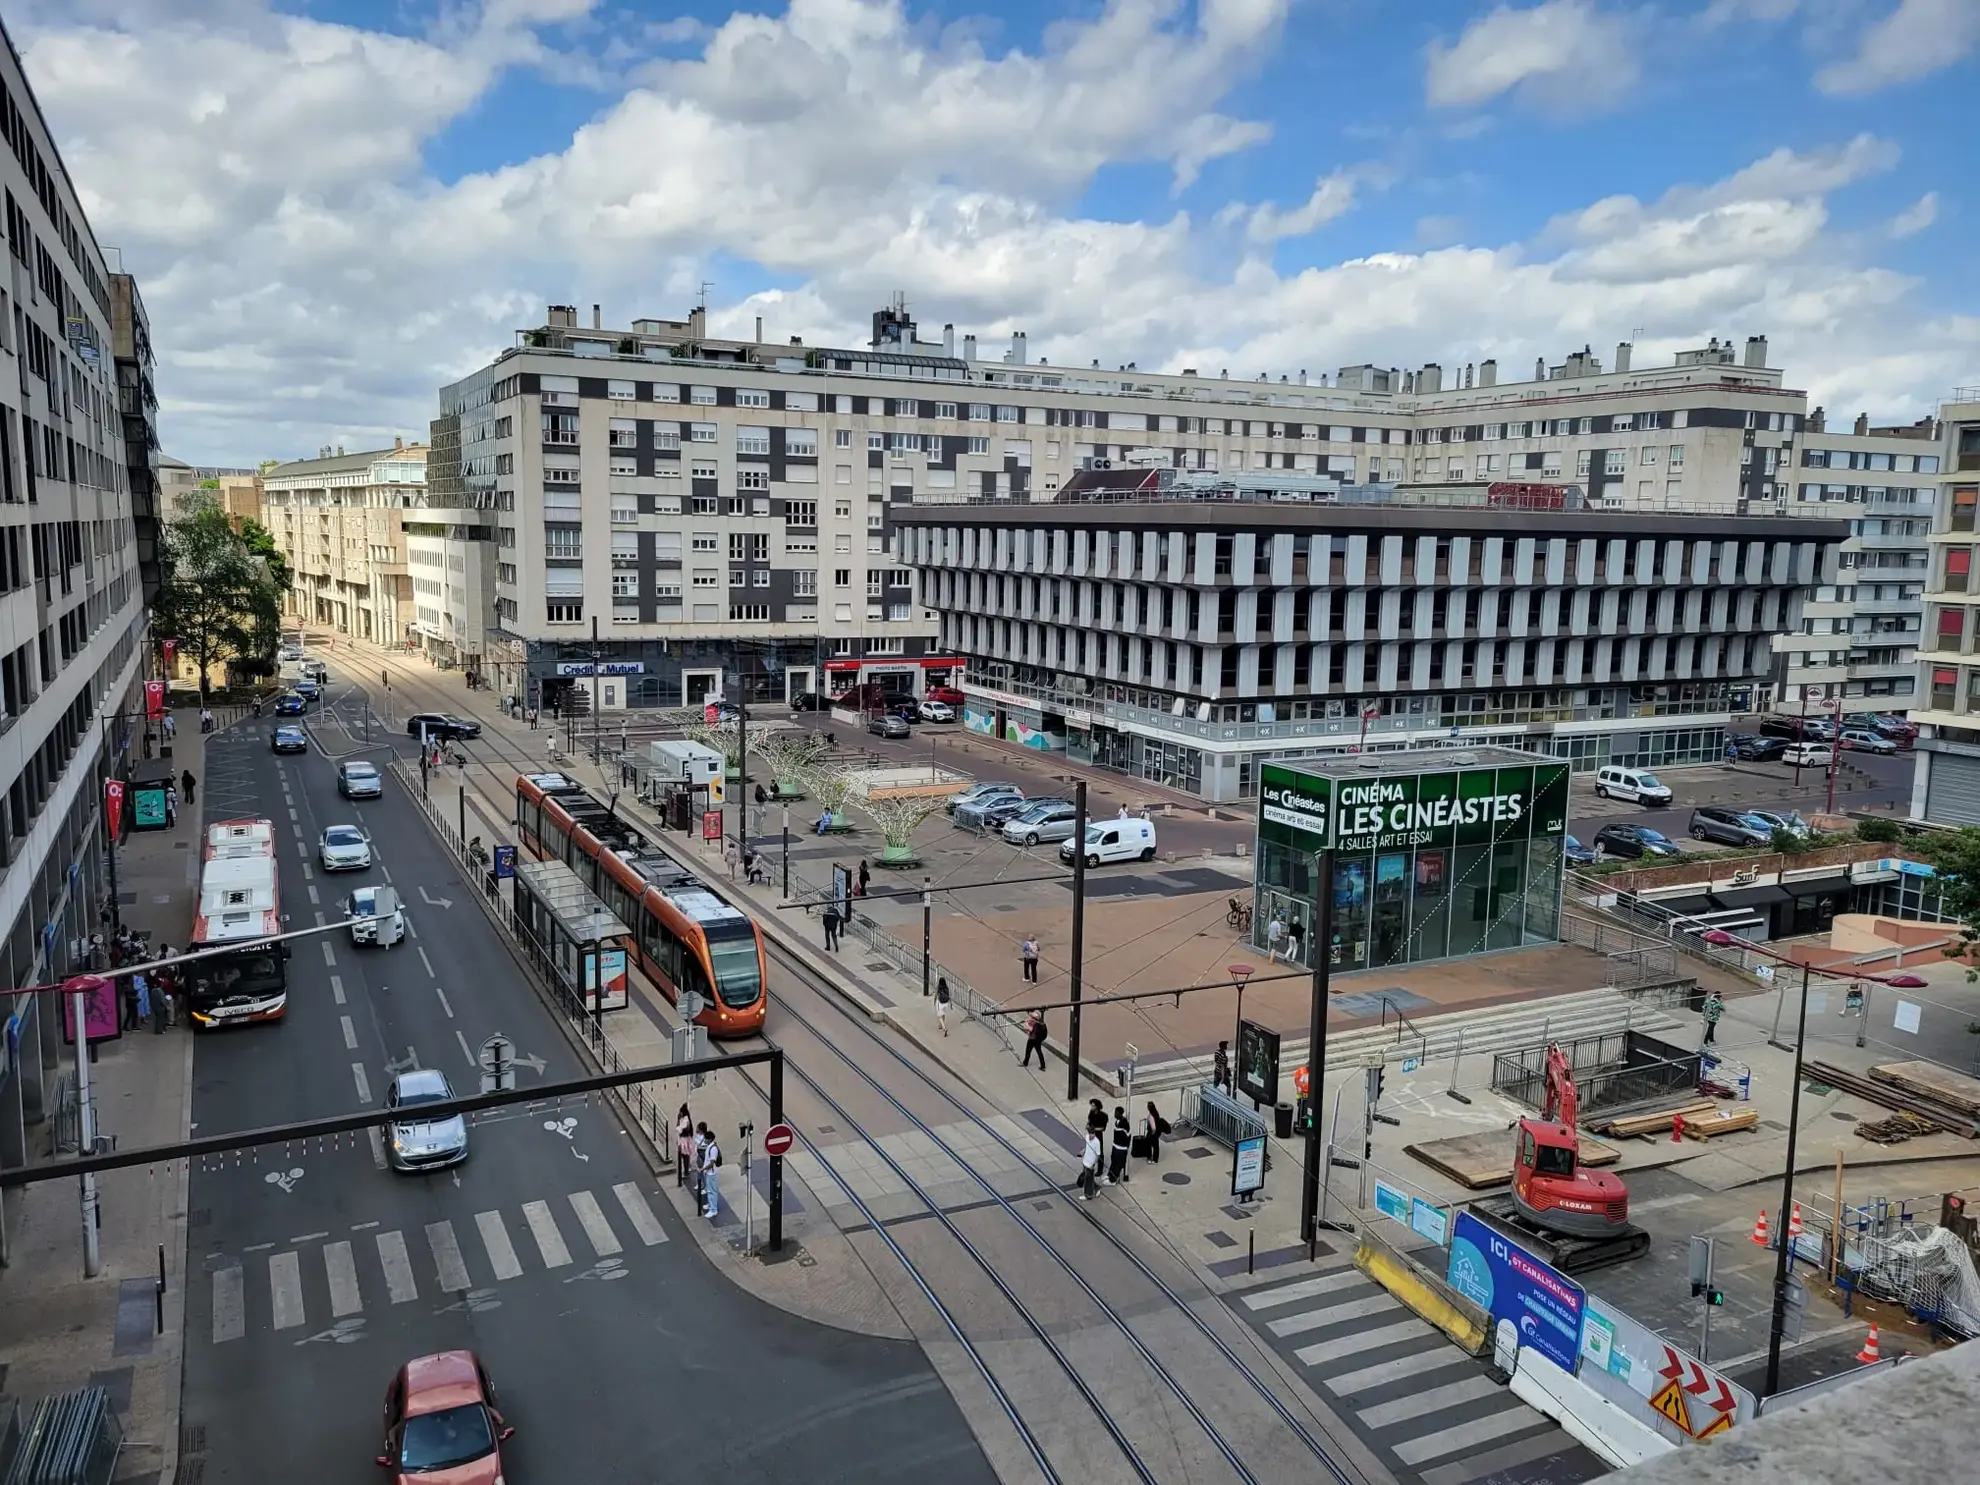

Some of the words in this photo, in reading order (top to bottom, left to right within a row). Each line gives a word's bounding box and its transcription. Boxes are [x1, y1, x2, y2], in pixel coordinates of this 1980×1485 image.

[564, 664, 594, 675] Crédit
[606, 664, 640, 674] Mutuel
[1264, 786, 1279, 801] Les
[1281, 789, 1326, 813] Cinéastes
[1341, 781, 1404, 805] CINÉMA
[1339, 805, 1385, 836] LES
[1390, 794, 1522, 830] CINÉASTES
[1338, 839, 1345, 851] 4
[1347, 836, 1377, 851] SALLES
[1379, 834, 1395, 847] ART
[1397, 832, 1407, 845] ET
[1408, 830, 1433, 844] ESSAI
[1565, 1201, 1592, 1210] LOXAM
[1490, 1237, 1512, 1266] ICI,
